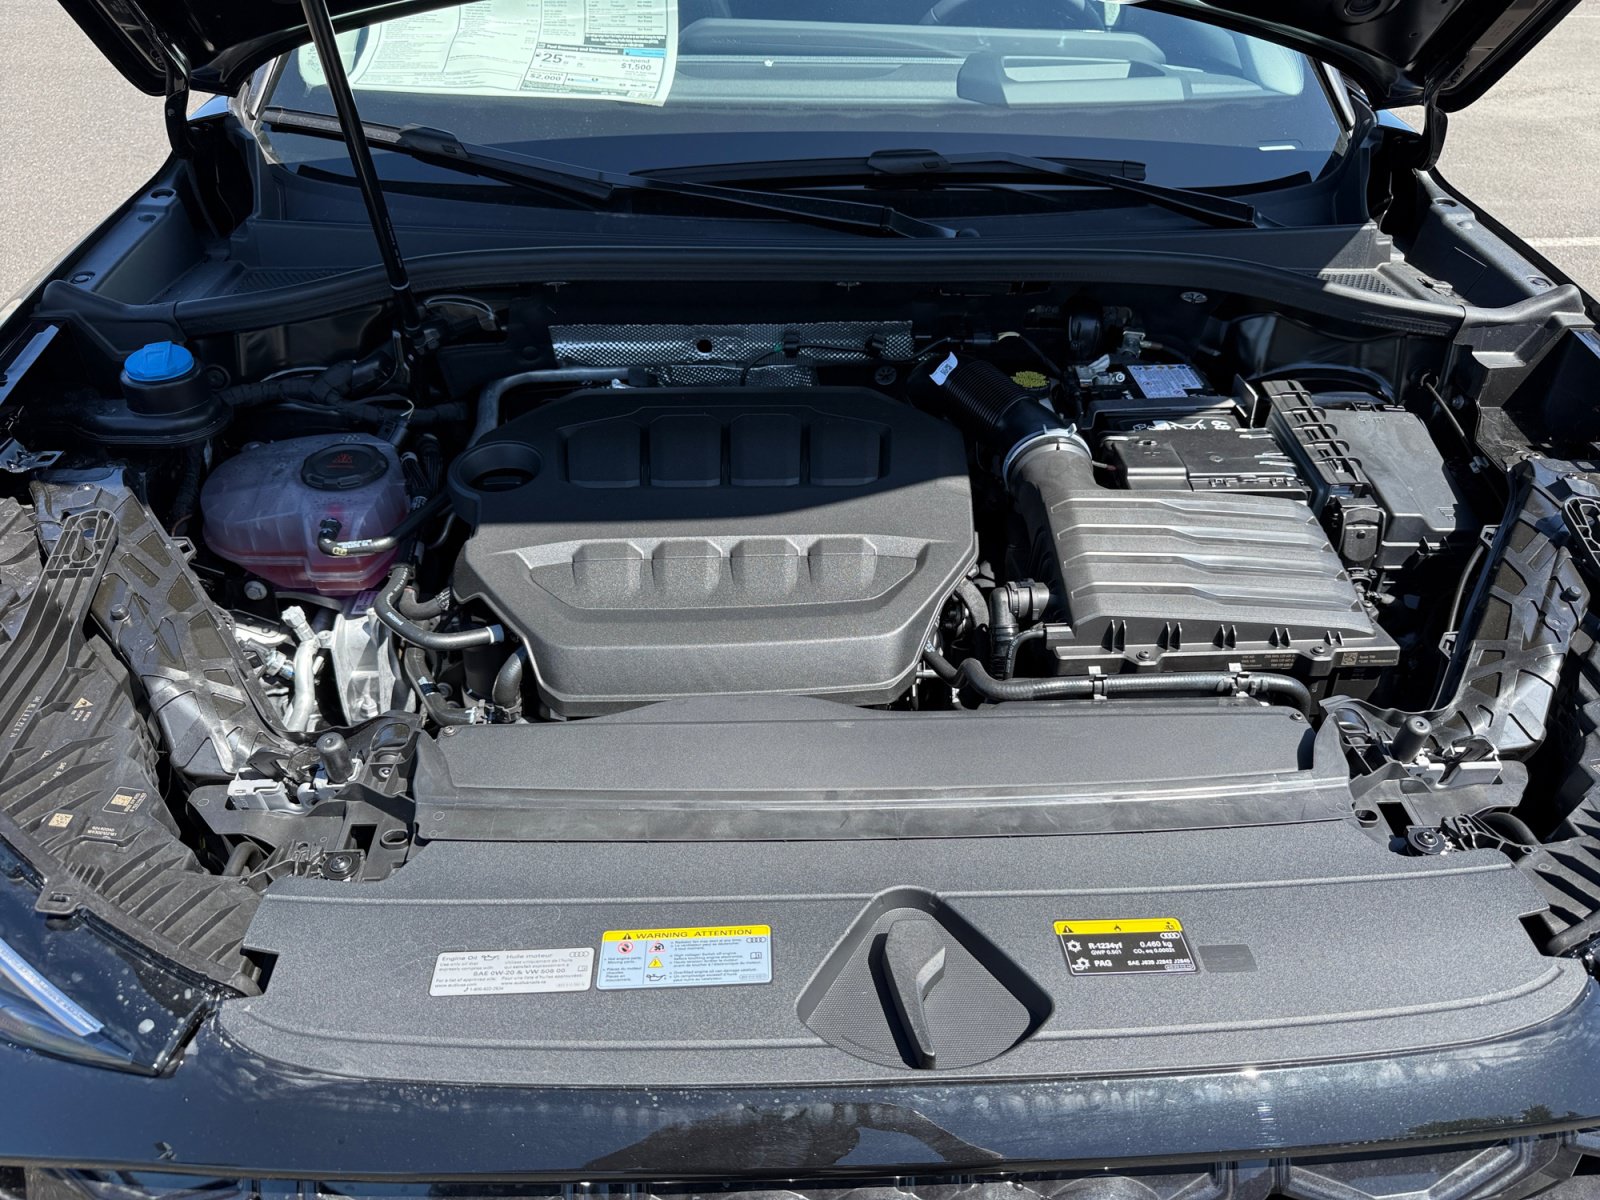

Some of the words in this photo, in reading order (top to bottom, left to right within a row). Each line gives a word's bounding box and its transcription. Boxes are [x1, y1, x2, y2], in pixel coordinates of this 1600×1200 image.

[541, 52, 563, 63] 25
[620, 62, 651, 71] $1,500
[530, 74, 562, 82] $2,000
[636, 931, 688, 939] WARNING
[694, 928, 752, 937] ATTENTION
[1162, 940, 1173, 948] kg
[1094, 959, 1112, 967] PAG
